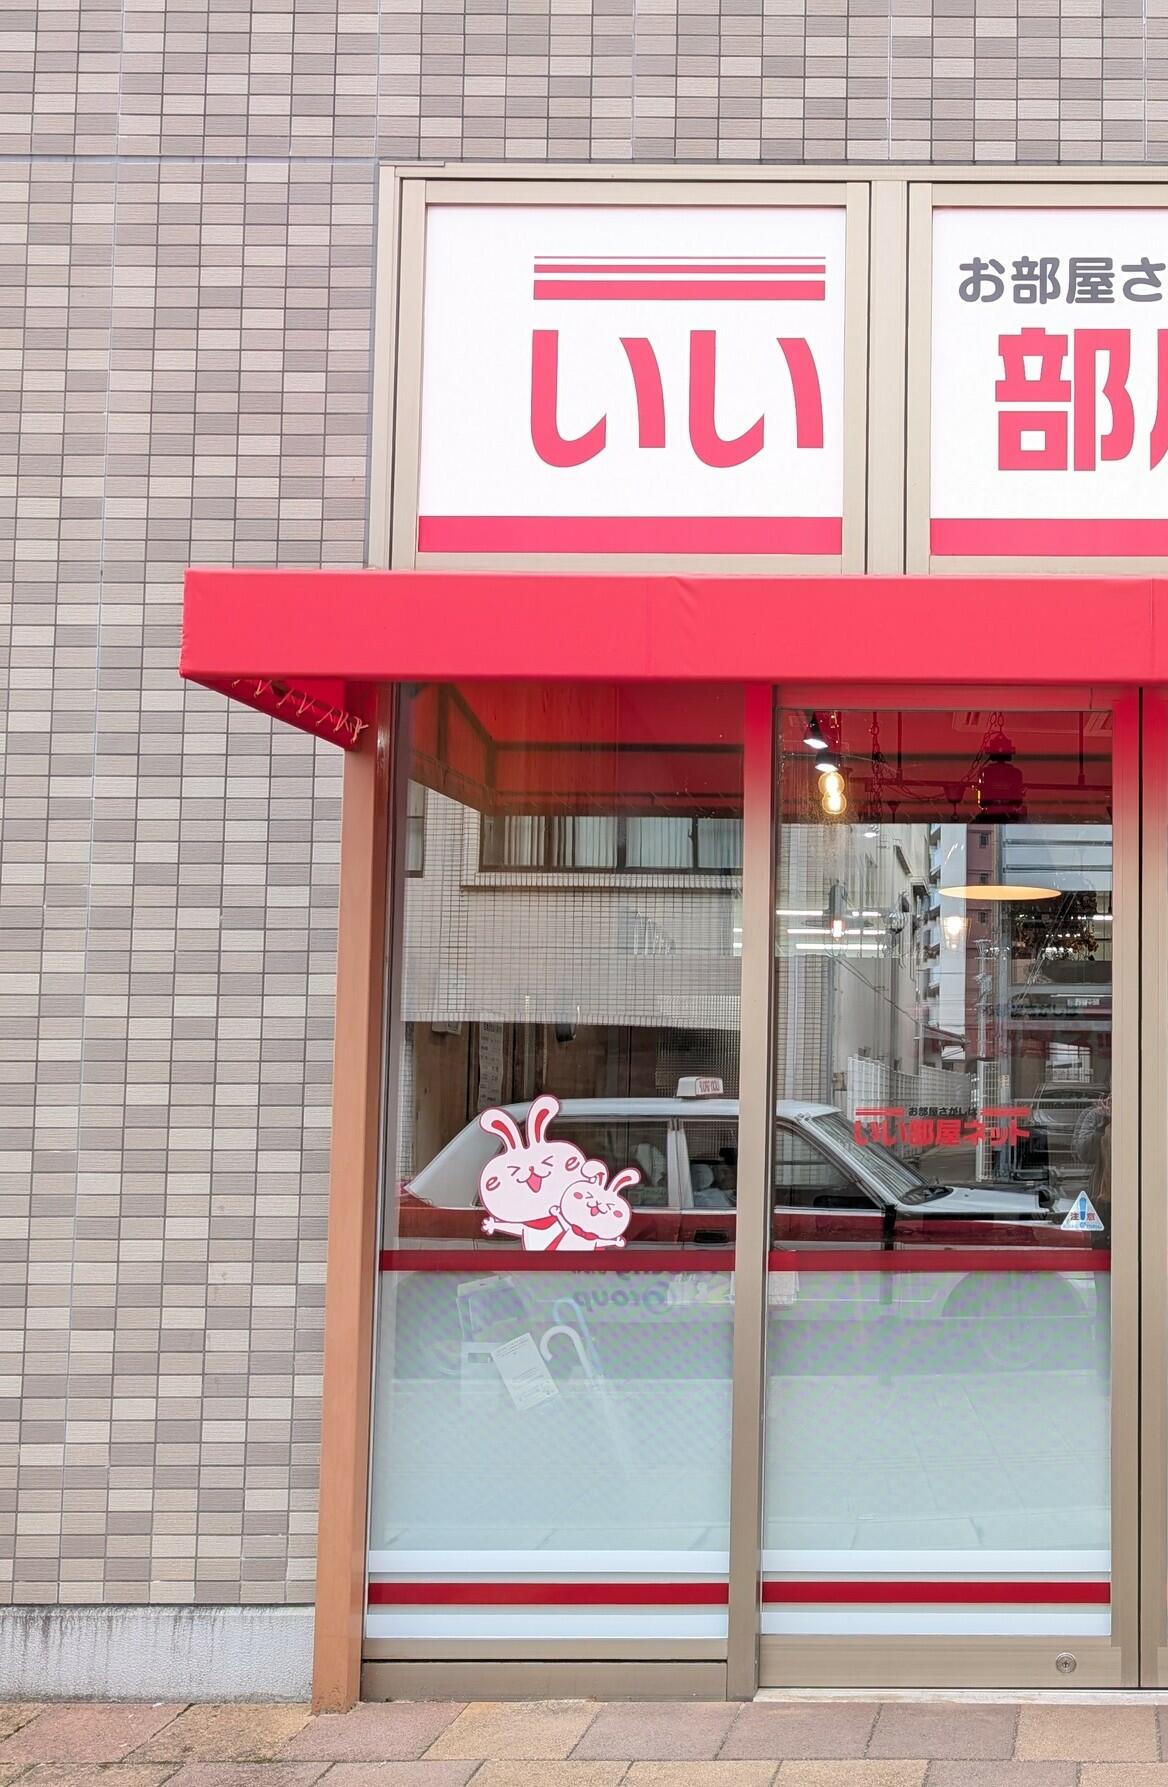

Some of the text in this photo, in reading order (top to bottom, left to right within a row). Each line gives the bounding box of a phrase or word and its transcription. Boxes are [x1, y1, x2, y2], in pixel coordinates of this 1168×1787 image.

[530, 328, 825, 468] いい
[908, 1106, 978, 1117] お部屋さがしは
[853, 1119, 1031, 1147] いい部屋ネット
